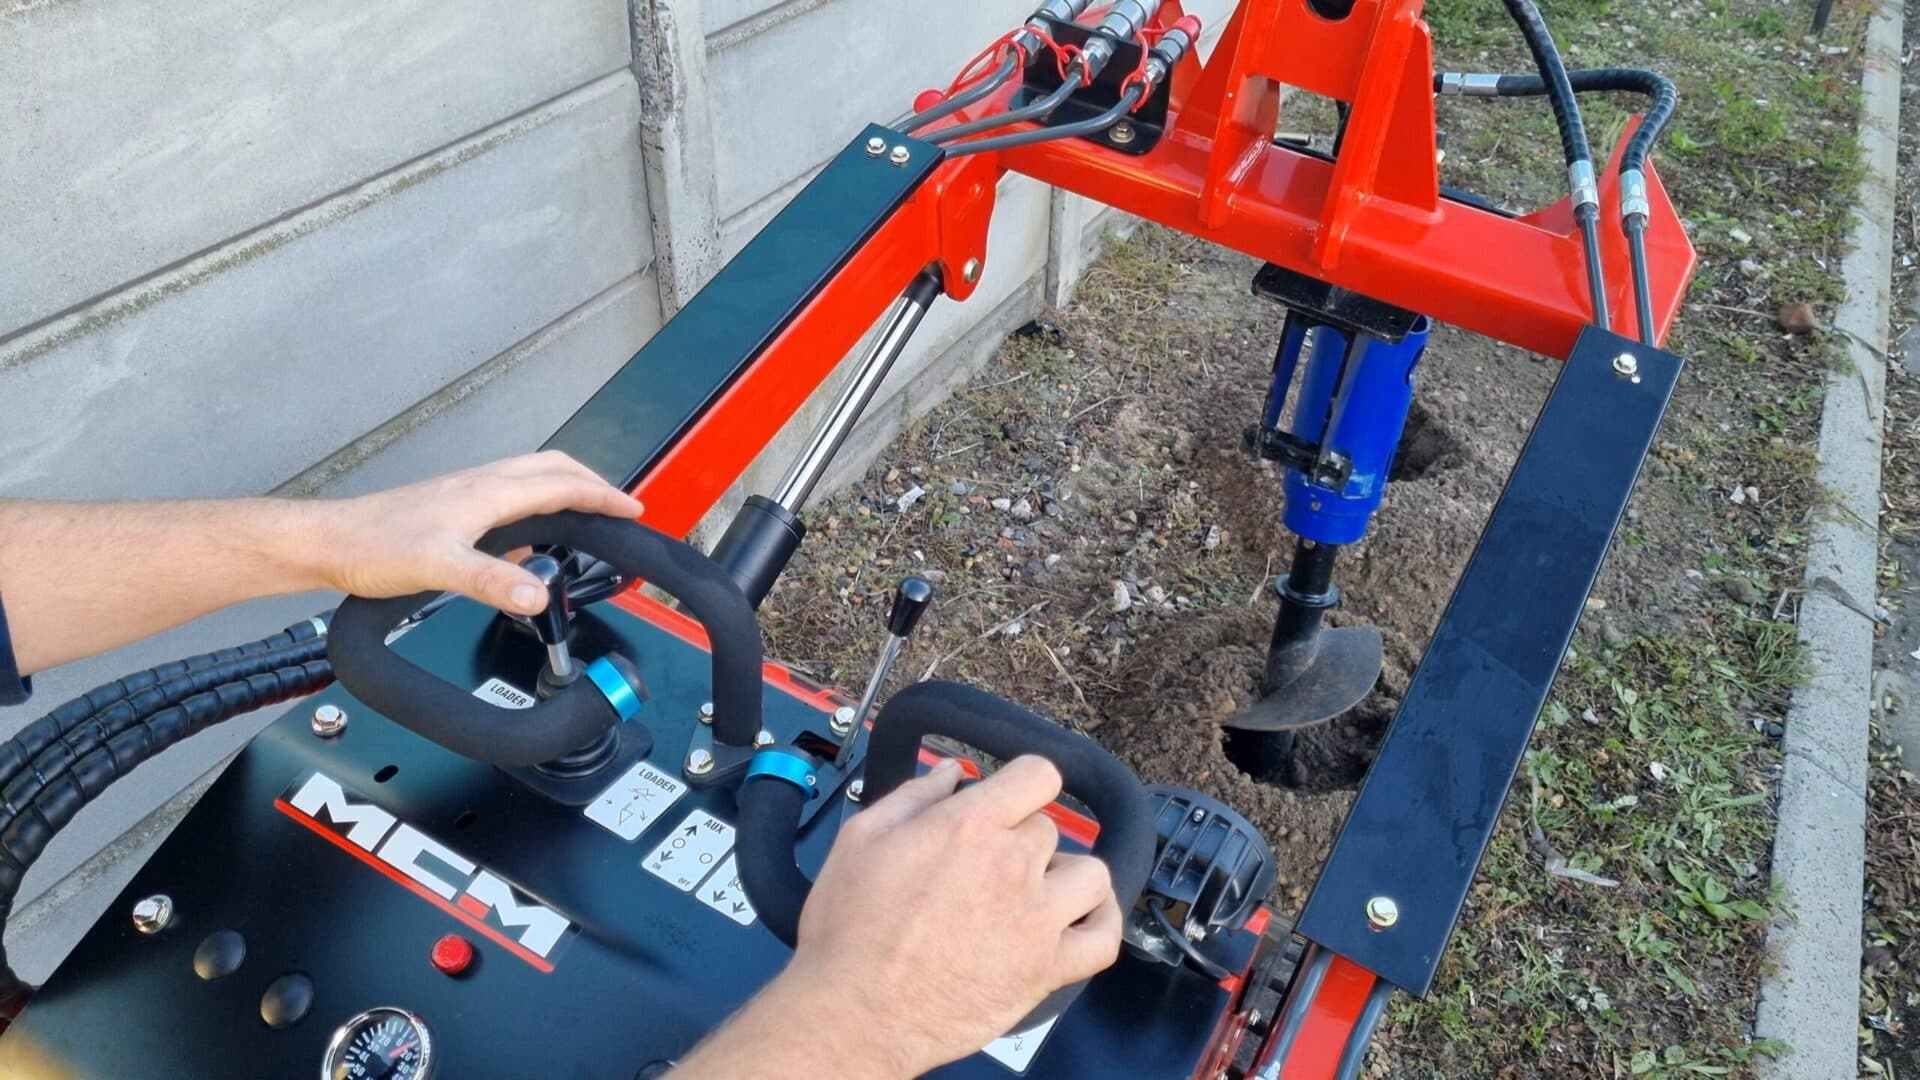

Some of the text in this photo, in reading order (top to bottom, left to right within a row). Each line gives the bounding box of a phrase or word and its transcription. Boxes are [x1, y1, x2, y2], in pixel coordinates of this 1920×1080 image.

[490, 683, 528, 707] LOADER
[638, 767, 677, 794] LOADER
[703, 818, 726, 835] AUX
[290, 772, 570, 958] MCM
